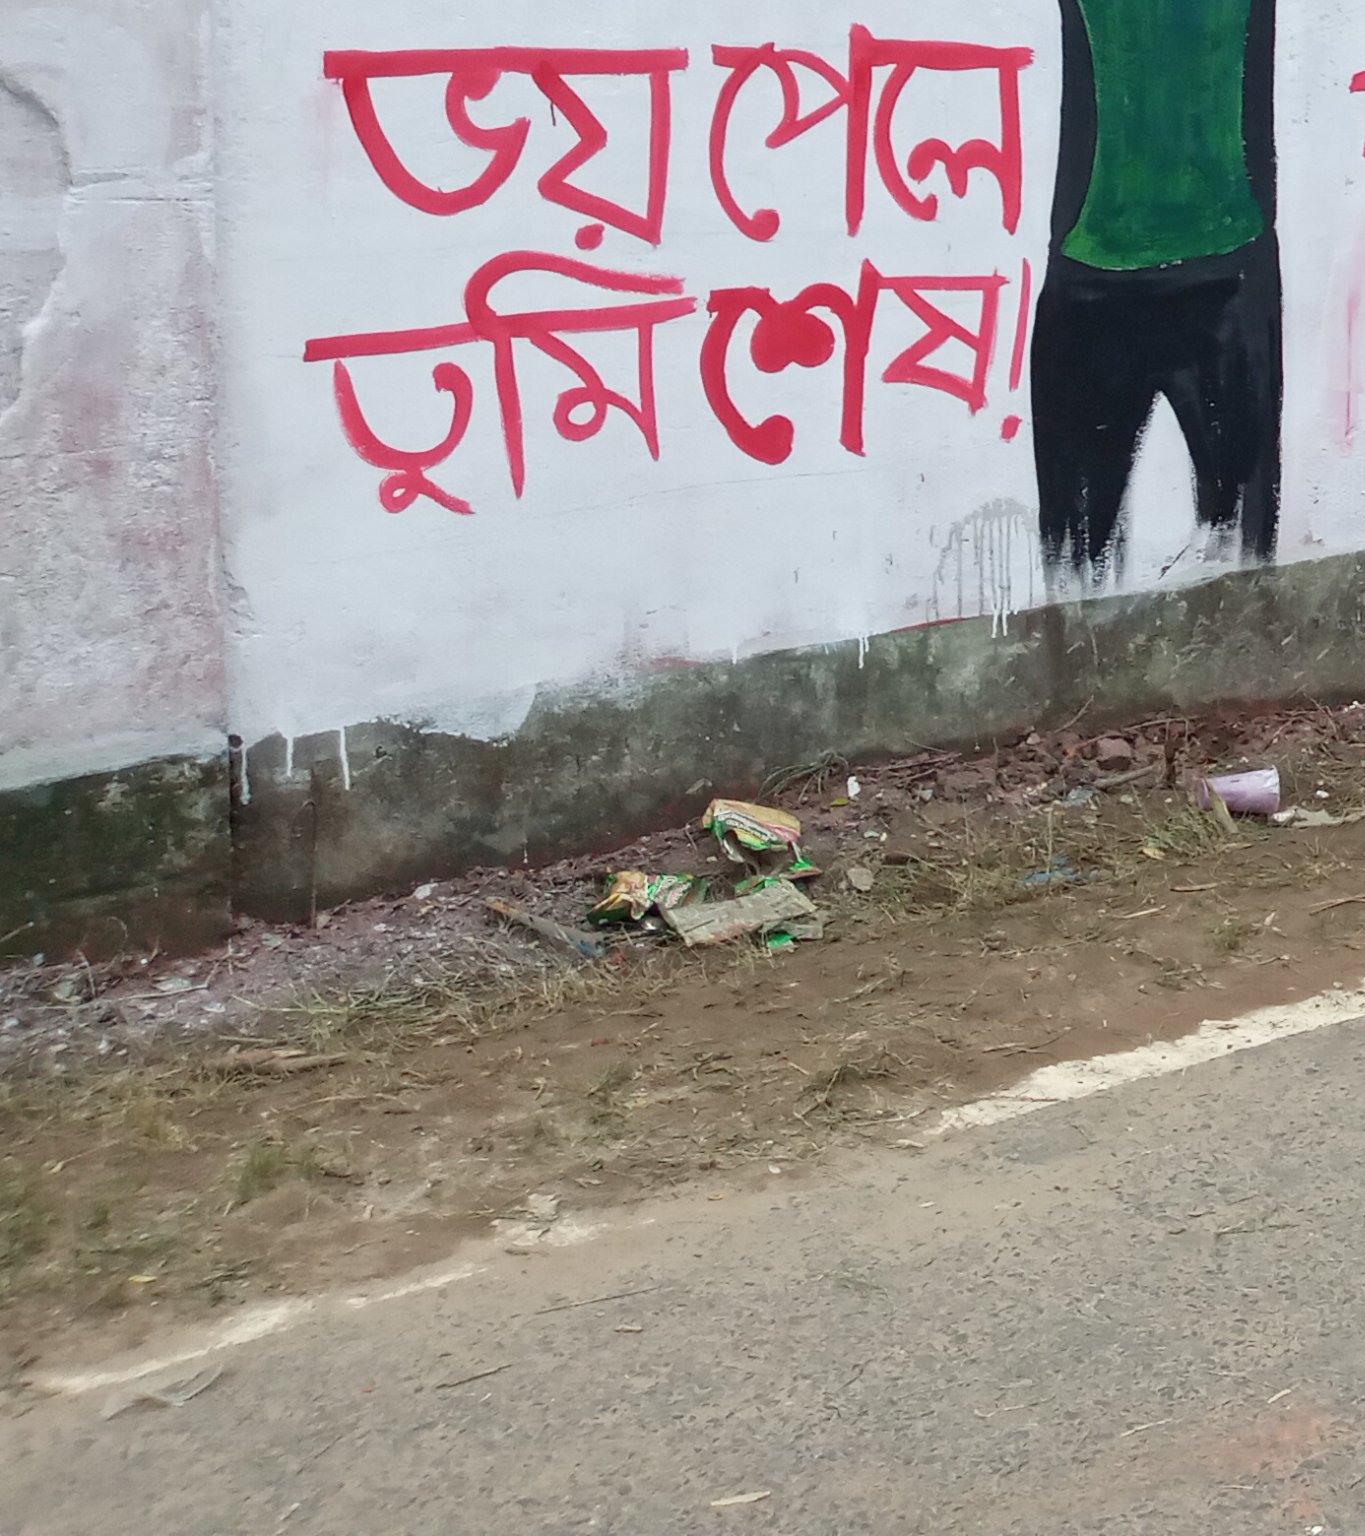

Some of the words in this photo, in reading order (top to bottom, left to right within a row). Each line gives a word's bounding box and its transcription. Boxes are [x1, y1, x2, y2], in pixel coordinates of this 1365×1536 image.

[323, 45, 689, 251] ভয়
[709, 22, 1035, 242] পেলে
[303, 249, 697, 516] তুমি
[699, 258, 1032, 466] শেষ!
